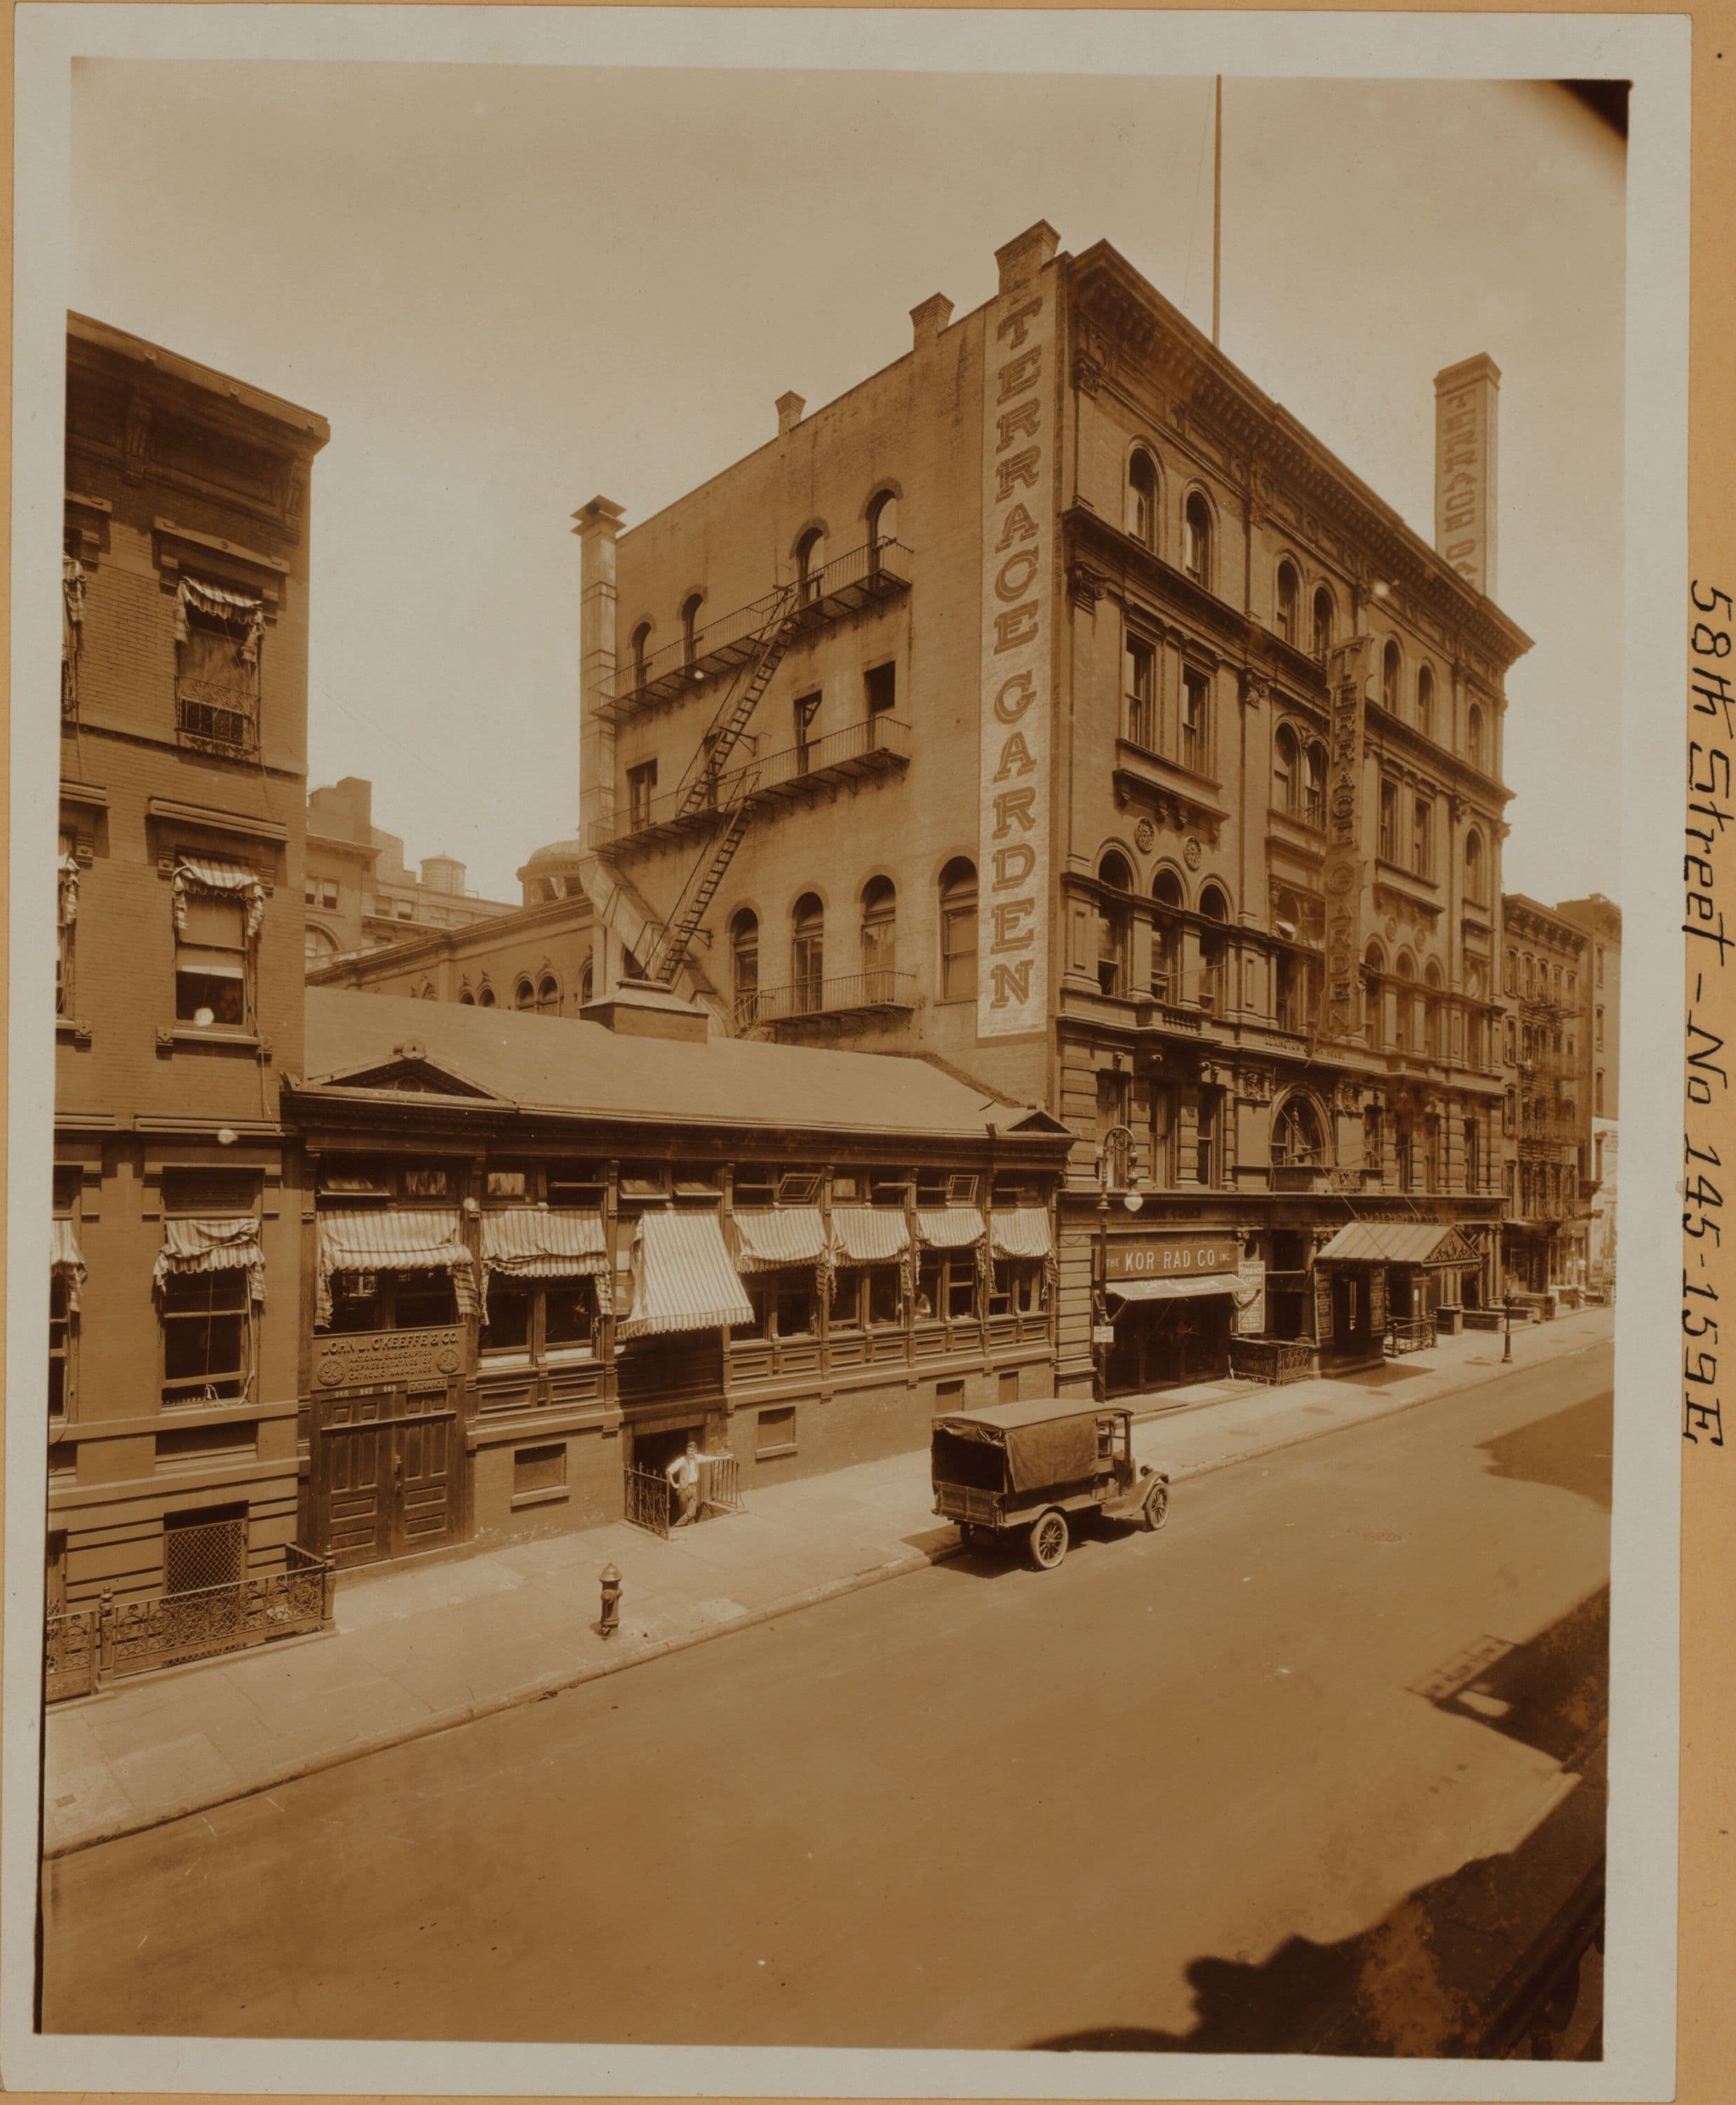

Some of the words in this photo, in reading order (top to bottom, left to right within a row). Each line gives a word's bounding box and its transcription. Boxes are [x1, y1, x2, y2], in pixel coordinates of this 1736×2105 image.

[992, 295, 1042, 655] TERRACE
[1444, 386, 1478, 533] TERRACE
[1688, 579, 1735, 739] 58th
[1333, 641, 1363, 845] TERRACE
[989, 670, 1037, 1009] GARDEN
[1682, 741, 1735, 967] Street
[1328, 861, 1356, 1029] GARDEN
[1687, 1009, 1727, 1105] No
[1107, 1258, 1119, 1268] THE
[1197, 1249, 1215, 1266] CO
[321, 1340, 355, 1356] JOHN
[358, 1340, 370, 1353] J.
[372, 1333, 428, 1352] O'KEEFFE
[430, 1333, 439, 1347] &
[442, 1331, 459, 1345] CO.
[349, 1354, 384, 1364] NATIONAL
[385, 1350, 433, 1361] SUBSCRIPTION
[349, 1361, 419, 1373] REPRESENTATIVES
[422, 1357, 433, 1365] OF
[349, 1368, 386, 1381] CATHOLIC
[389, 1365, 433, 1377] MAGAZINES
[409, 1380, 445, 1393] ENTRANCE
